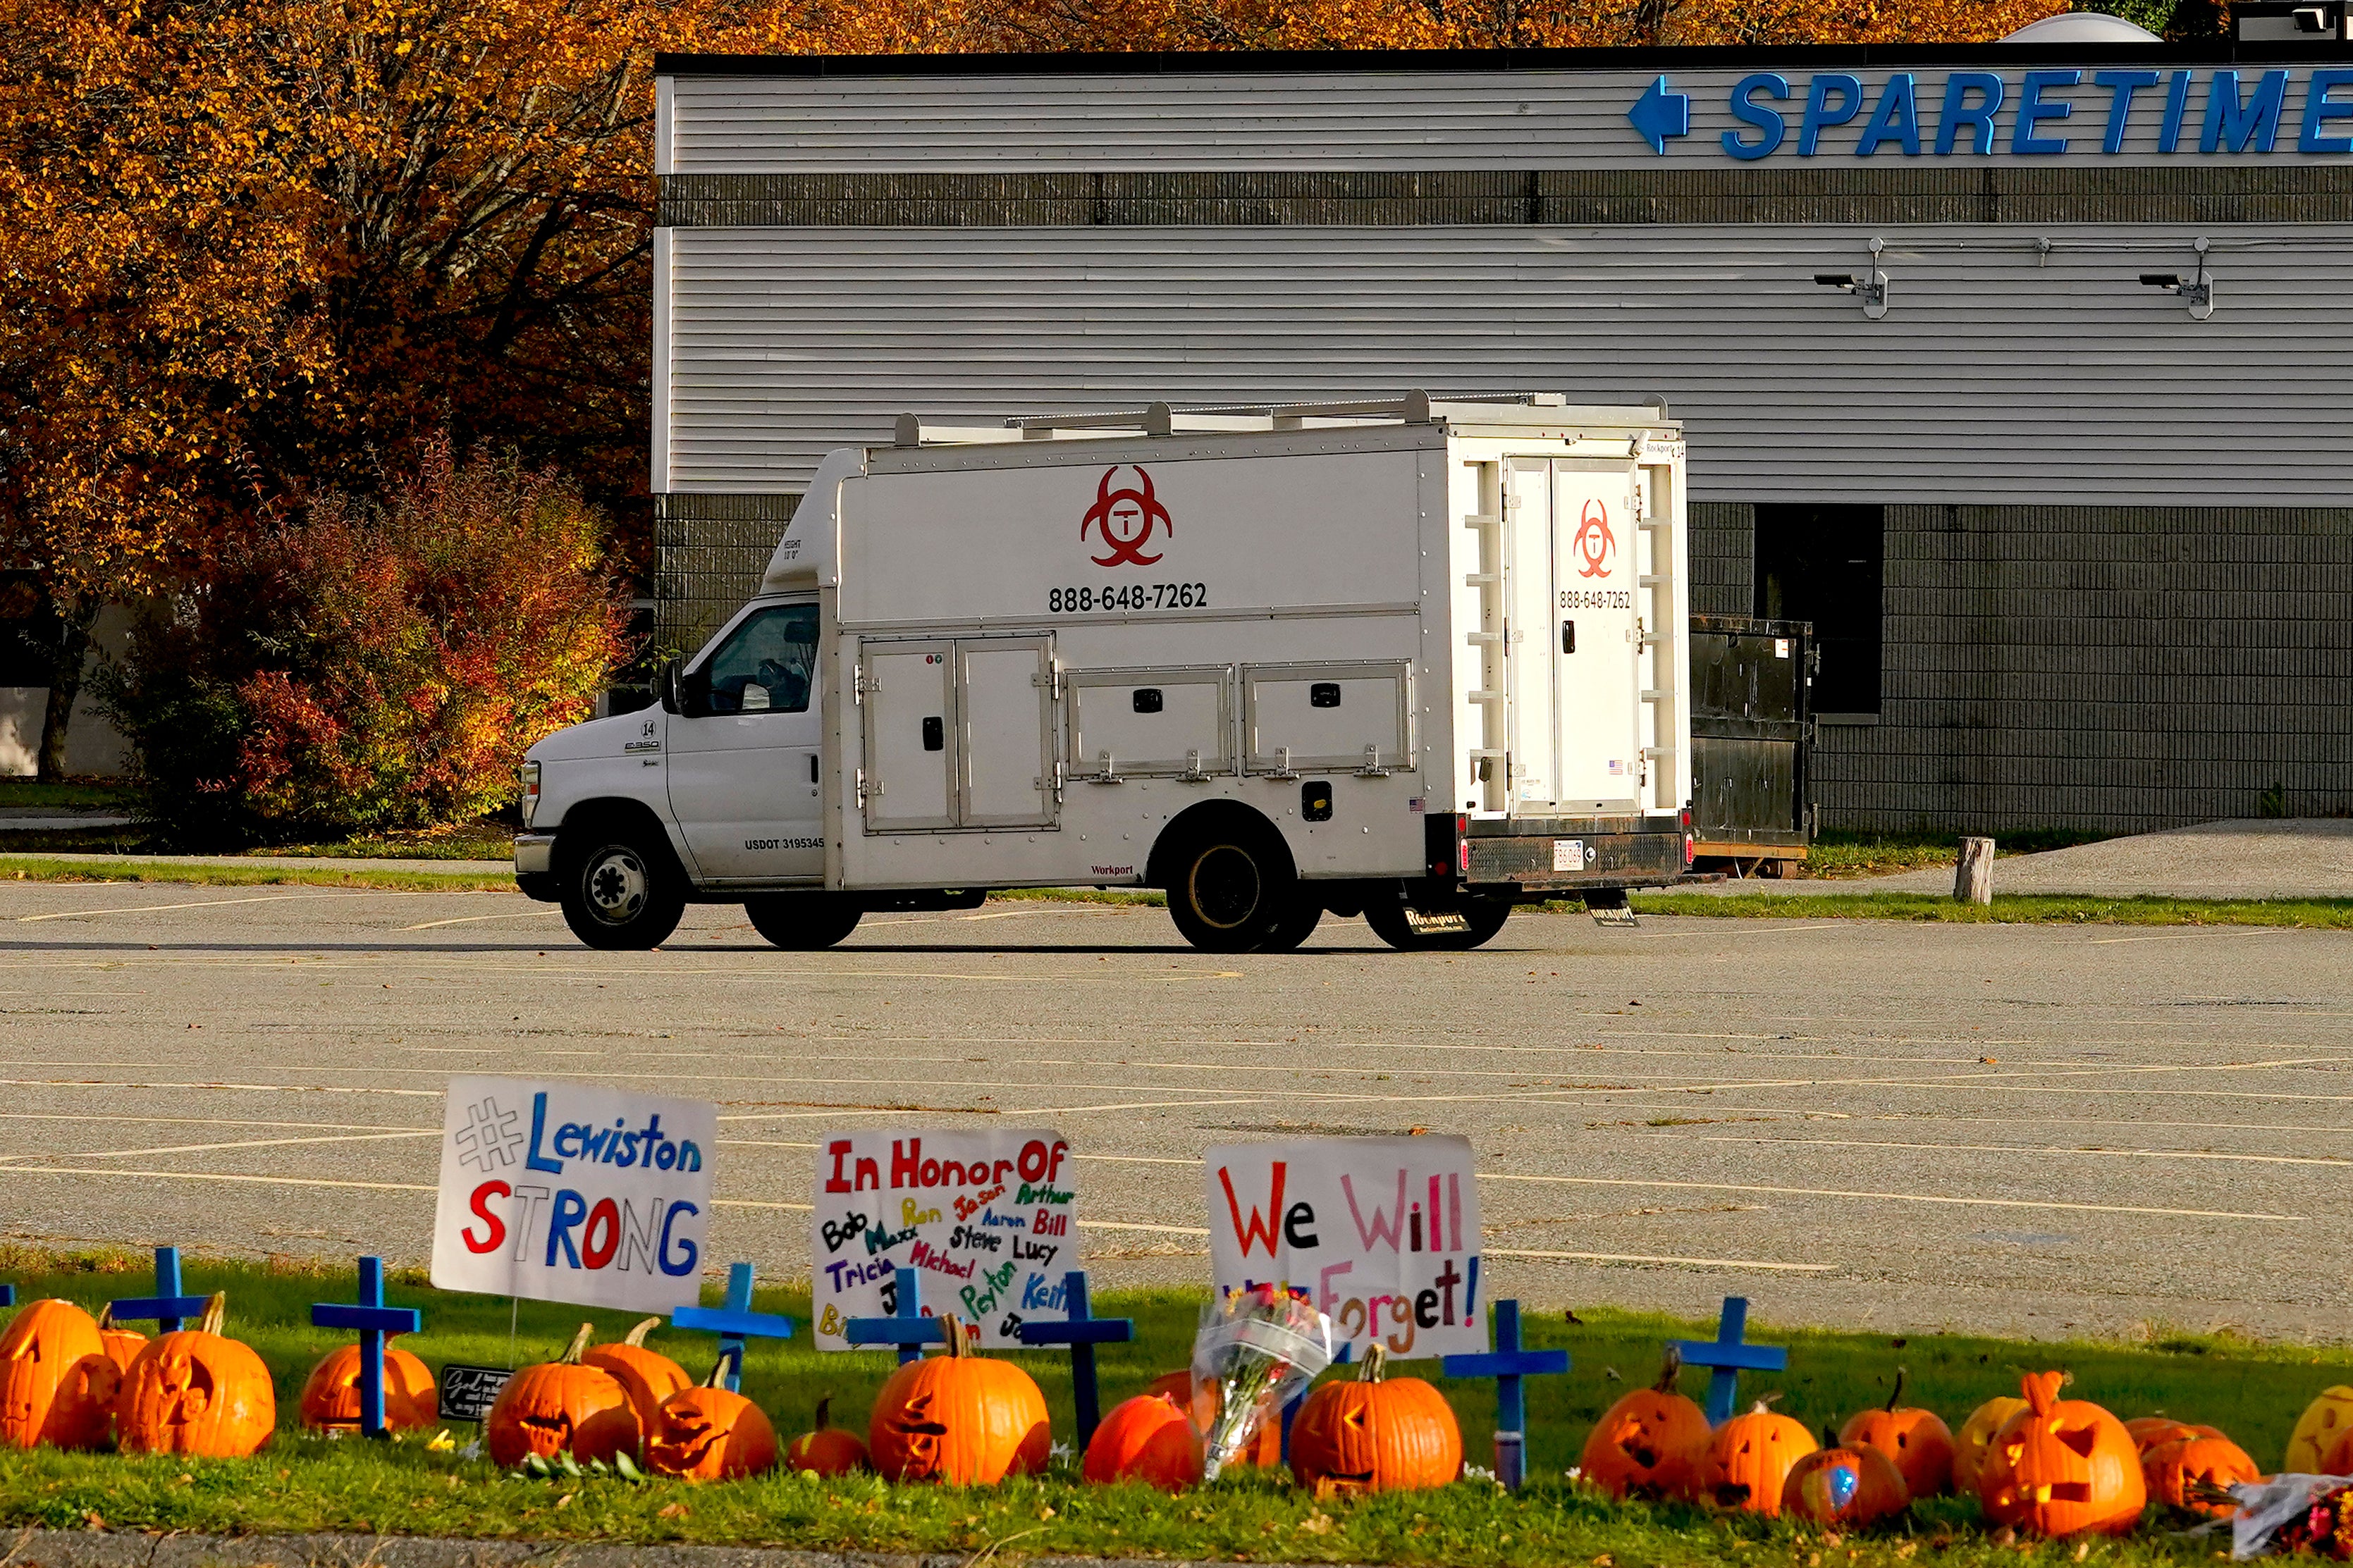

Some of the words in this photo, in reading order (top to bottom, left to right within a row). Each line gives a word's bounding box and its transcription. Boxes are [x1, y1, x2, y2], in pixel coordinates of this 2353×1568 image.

[1049, 582, 1208, 613] 888-648-7262
[1560, 591, 1630, 609] 888-648-7262
[643, 722, 654, 736] 14
[745, 839, 780, 850] USDOT
[782, 837, 825, 849] 3195345
[1091, 865, 1134, 877] Workport
[825, 1139, 880, 1193] In
[890, 1137, 1014, 1188] Honor
[1017, 1139, 1069, 1183] Of
[1014, 1182, 1075, 1204] Arthur
[901, 1197, 942, 1227] Ron
[981, 1206, 1026, 1228] Aaron
[1032, 1207, 1068, 1237] Bill
[1217, 1161, 1320, 1259] We
[1340, 1168, 1463, 1254] Will
[462, 1179, 700, 1276] STRONG
[821, 1209, 868, 1253] Bob
[950, 1224, 1002, 1252] Steve
[909, 1238, 976, 1280] Michael
[1013, 1234, 1059, 1267] Lucy
[825, 1257, 896, 1293] Tricia
[959, 1260, 1018, 1321] Peyton
[1319, 1255, 1480, 1354] Forget!
[446, 1369, 483, 1399] God
